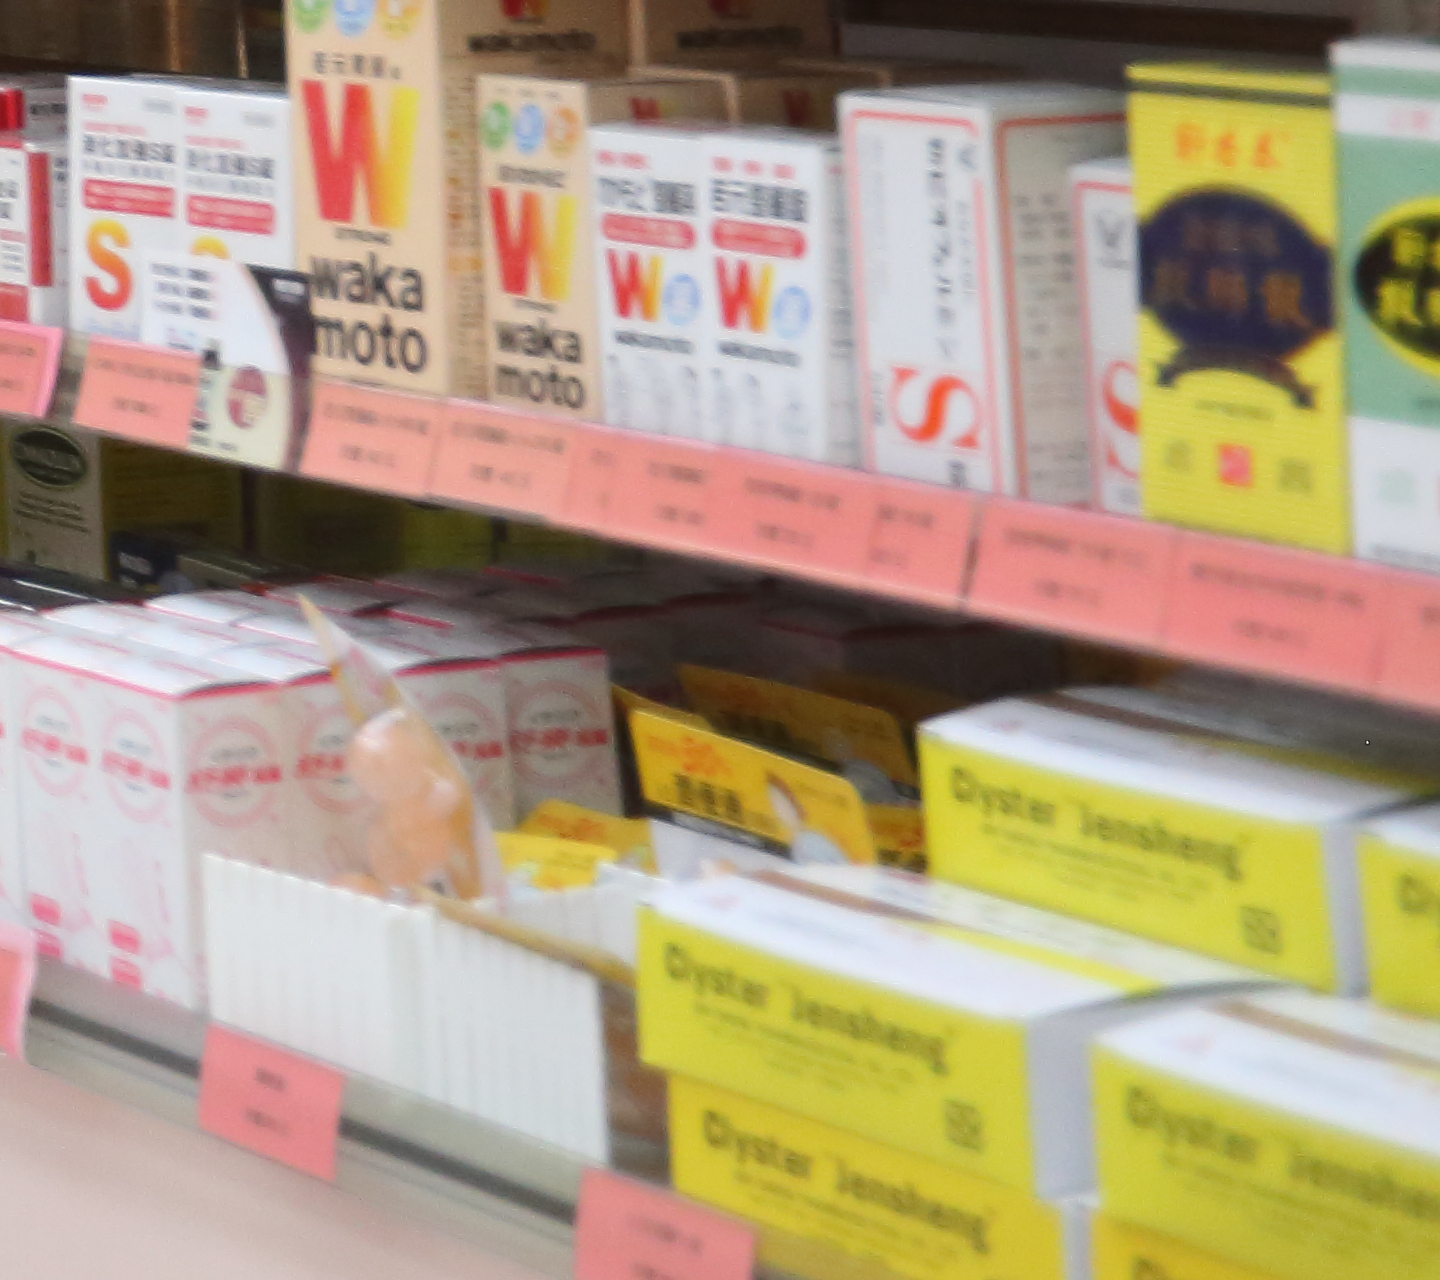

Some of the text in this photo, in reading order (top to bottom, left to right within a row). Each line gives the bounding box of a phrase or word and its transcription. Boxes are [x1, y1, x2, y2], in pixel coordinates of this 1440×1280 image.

[300, 79, 420, 229] W
[85, 219, 132, 311] S
[489, 186, 576, 301] W
[311, 251, 425, 313] waka
[606, 247, 663, 322] W
[715, 255, 774, 333] W
[313, 316, 428, 373] moto
[495, 318, 582, 362] waka
[495, 363, 584, 409] moto
[949, 767, 1056, 828] Oyster
[664, 944, 770, 1008] Oyster
[702, 1110, 813, 1179] Oyster
